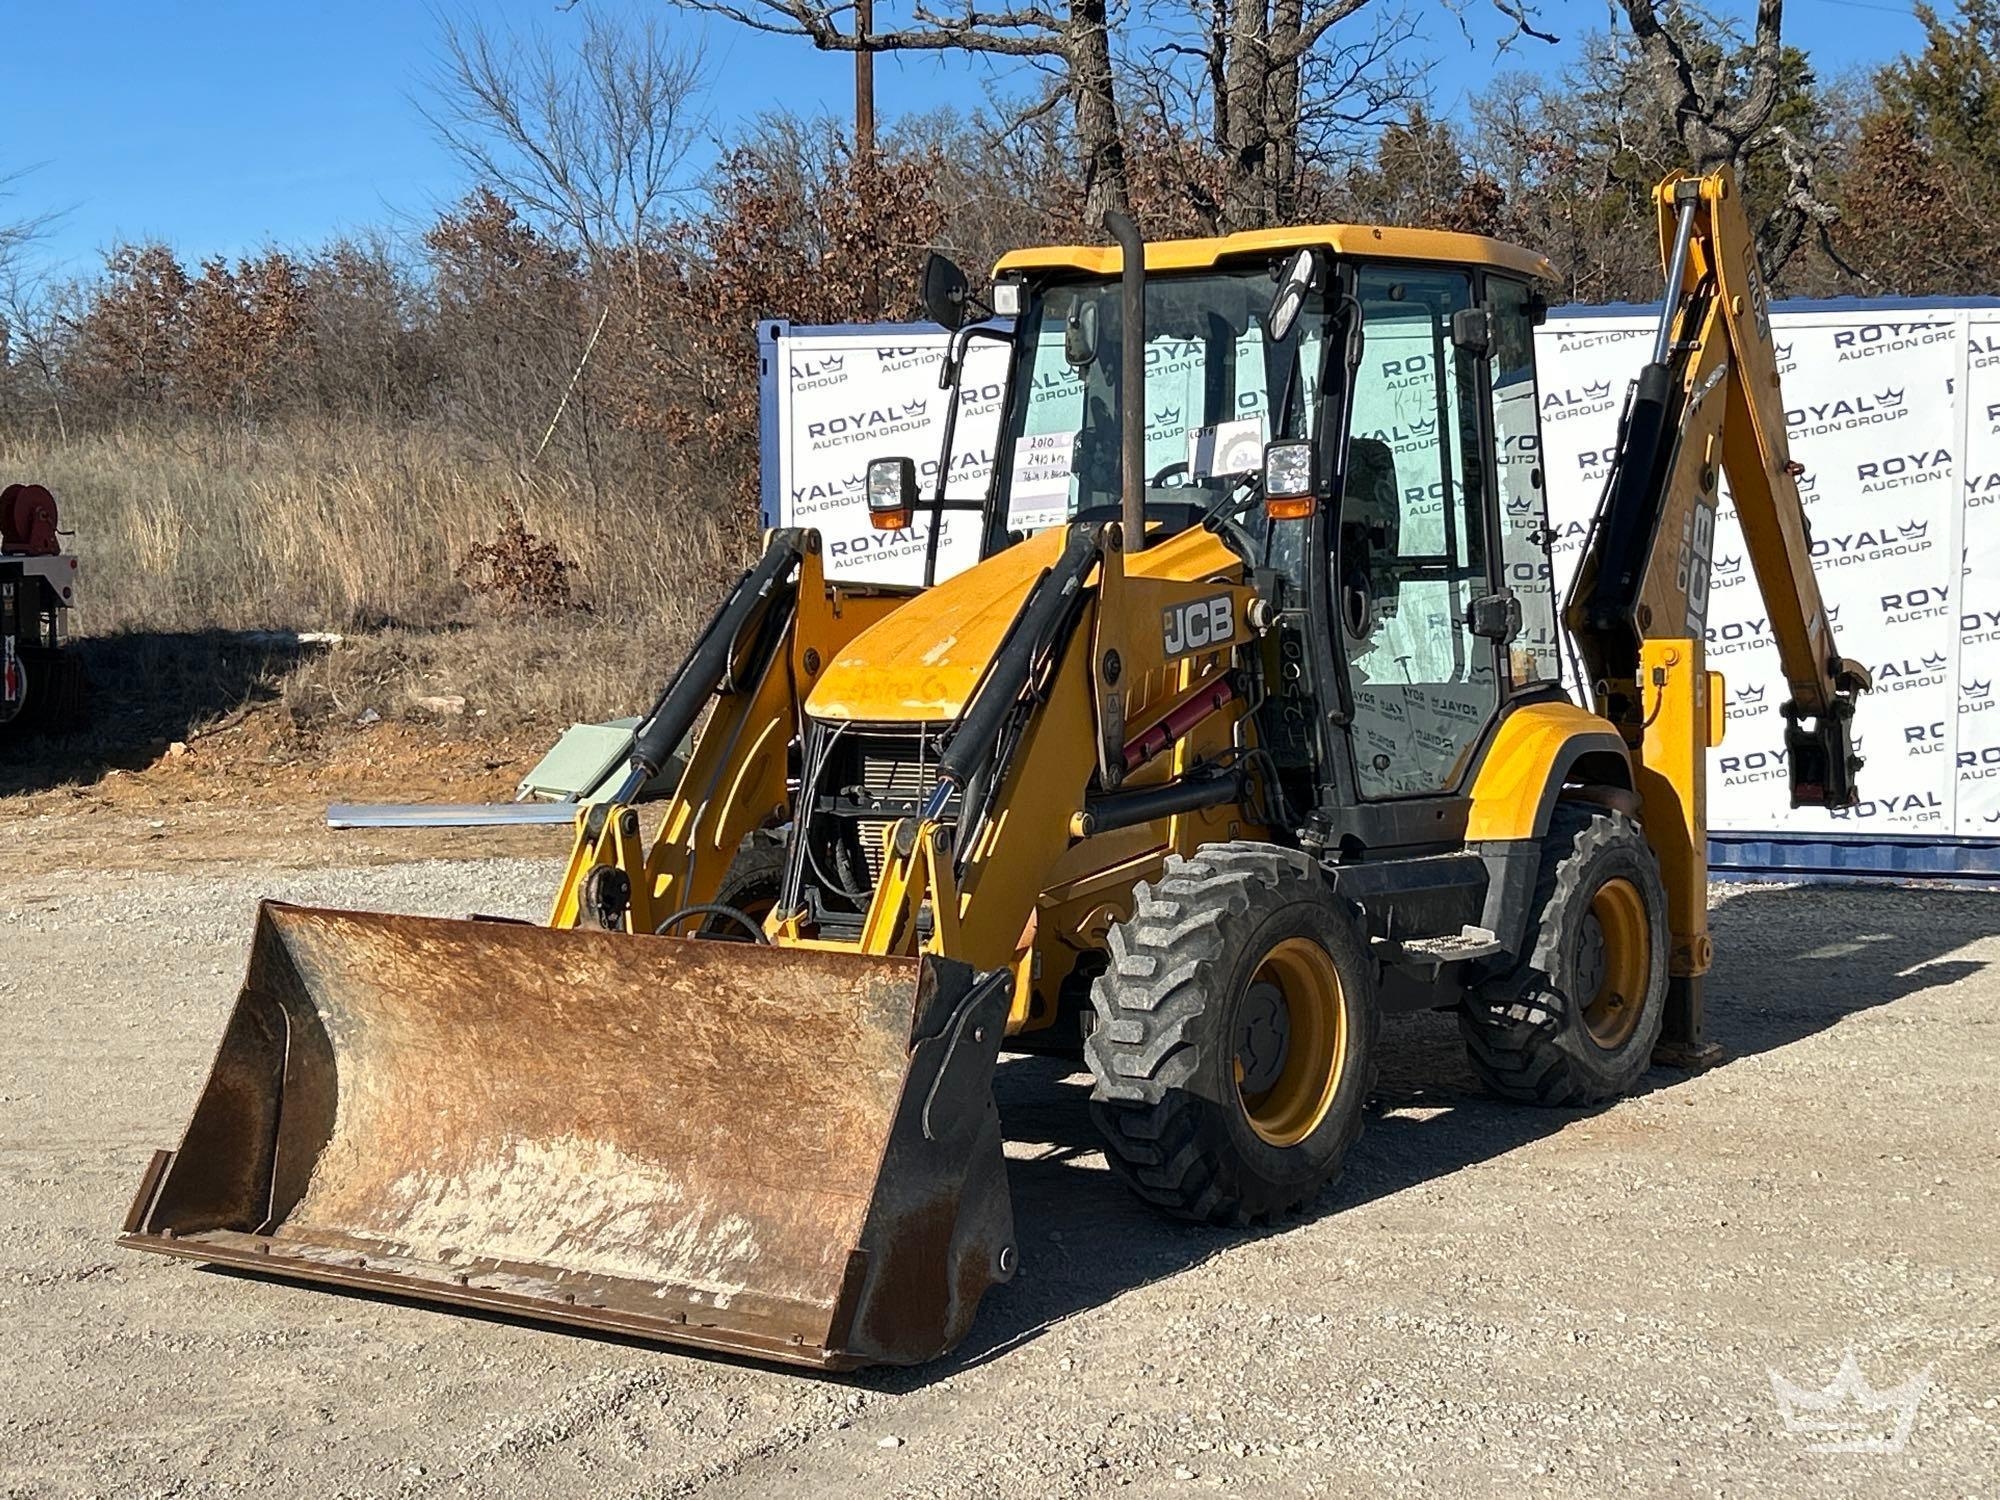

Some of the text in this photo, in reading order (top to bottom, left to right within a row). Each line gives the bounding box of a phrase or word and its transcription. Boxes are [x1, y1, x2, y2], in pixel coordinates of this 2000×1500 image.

[1560, 331, 1635, 353] AUCTION
[1838, 338, 1919, 362] AUCTION
[797, 374, 848, 392] GROUP
[1555, 401, 1615, 421] GROUP
[1845, 408, 1908, 428] GROUP
[808, 407, 903, 438] ROYAL
[813, 418, 931, 451] AUCTION GROUP
[1030, 437, 1054, 449] 2010
[1862, 470, 1941, 494] AUCTION
[830, 526, 924, 557] ROYAL
[1869, 540, 1932, 561] GROUP
[834, 551, 898, 569] AUCTION
[1165, 596, 1233, 654] JCB
